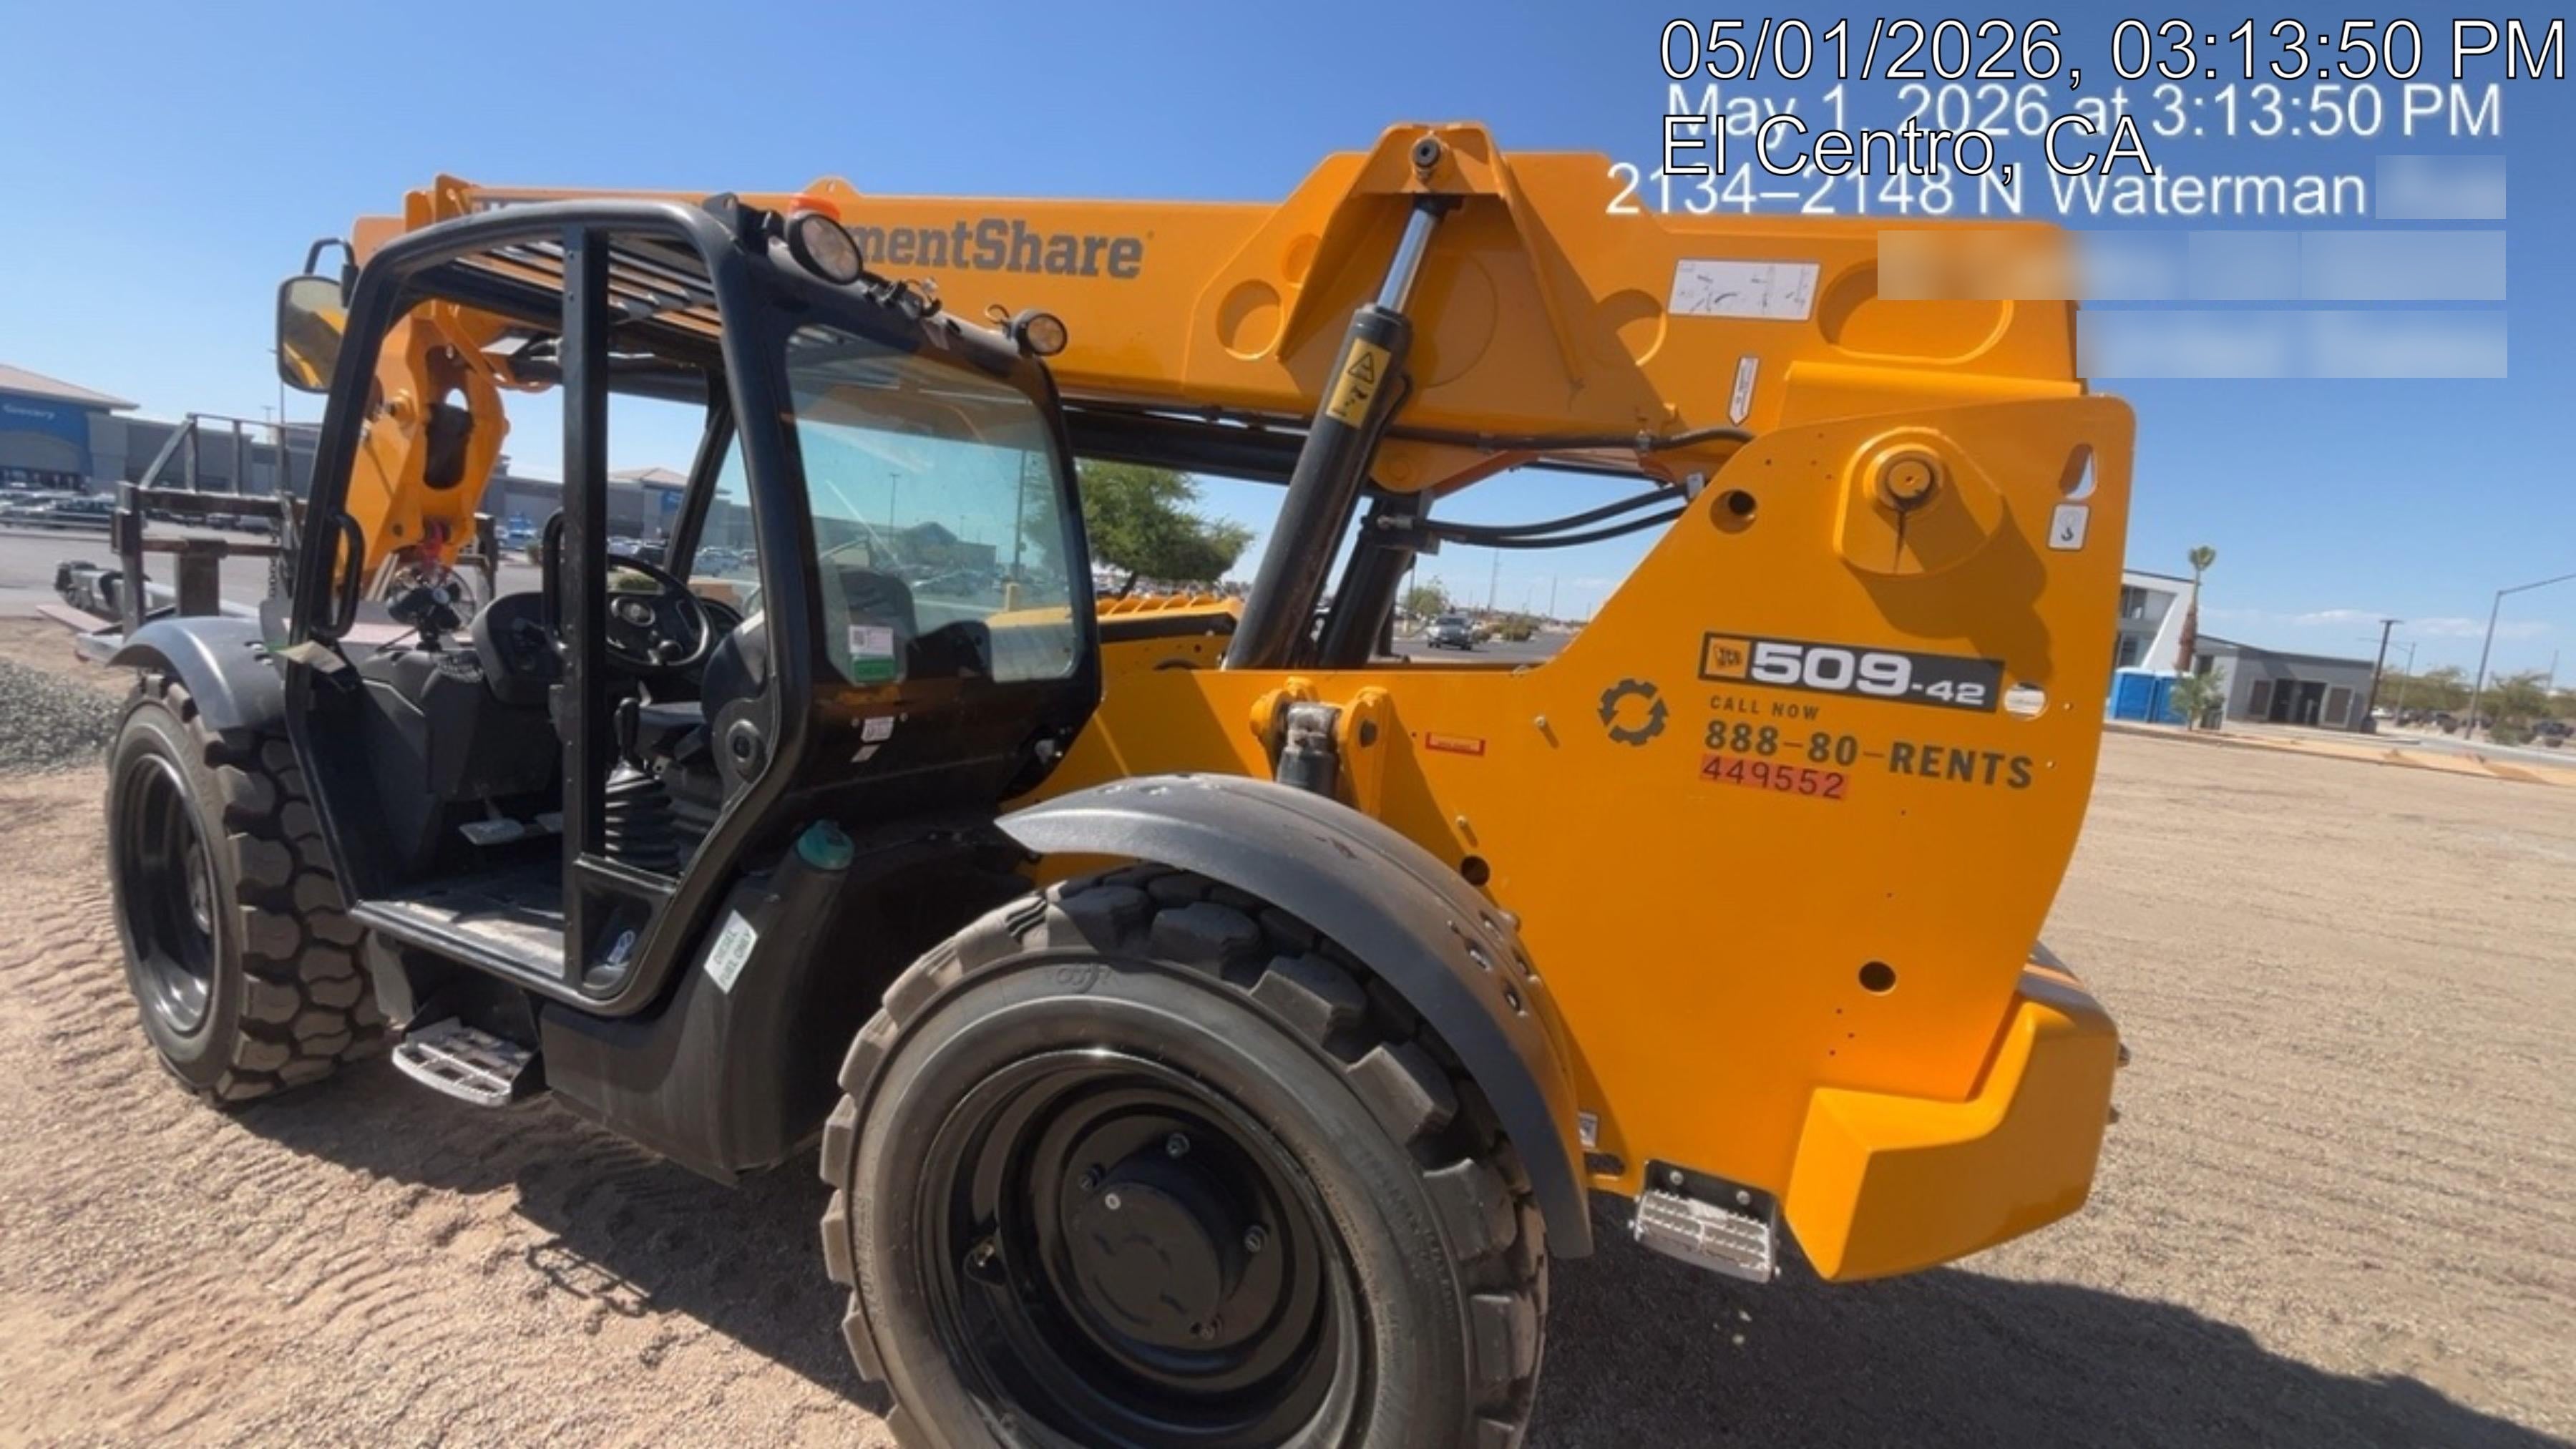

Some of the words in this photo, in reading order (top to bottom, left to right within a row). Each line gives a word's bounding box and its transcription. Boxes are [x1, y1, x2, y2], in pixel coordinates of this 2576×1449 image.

[1750, 640, 1986, 706] 509-42
[1710, 694, 1760, 715] CALL
[1772, 701, 1820, 721] NOW
[1702, 754, 1846, 800] 449552
[1704, 719, 2033, 789] 888-80-RENTS
